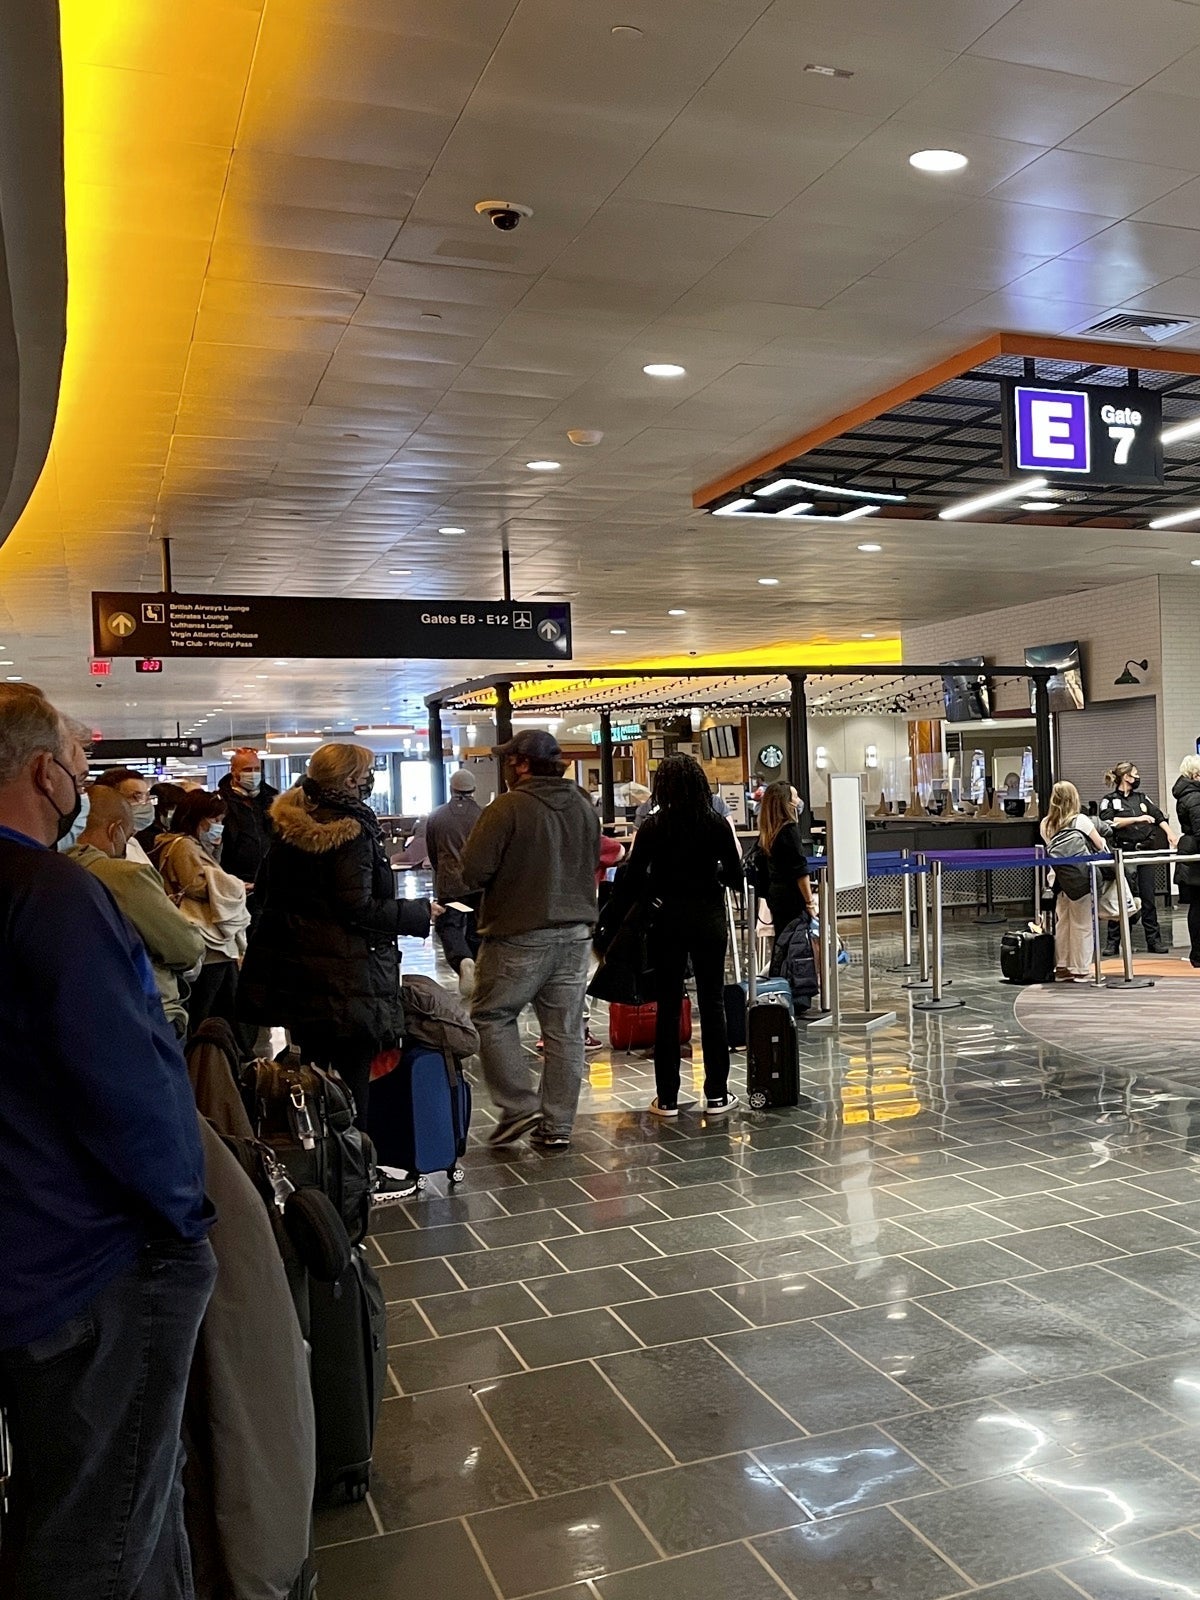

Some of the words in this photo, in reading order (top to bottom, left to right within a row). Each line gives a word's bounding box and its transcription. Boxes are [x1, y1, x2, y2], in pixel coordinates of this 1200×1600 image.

[1101, 405, 1142, 425] Gate
[1031, 400, 1074, 460] E
[1108, 426, 1135, 464] 7
[421, 613, 457, 624] Gates
[460, 614, 476, 624] E8
[486, 614, 509, 625] E12
